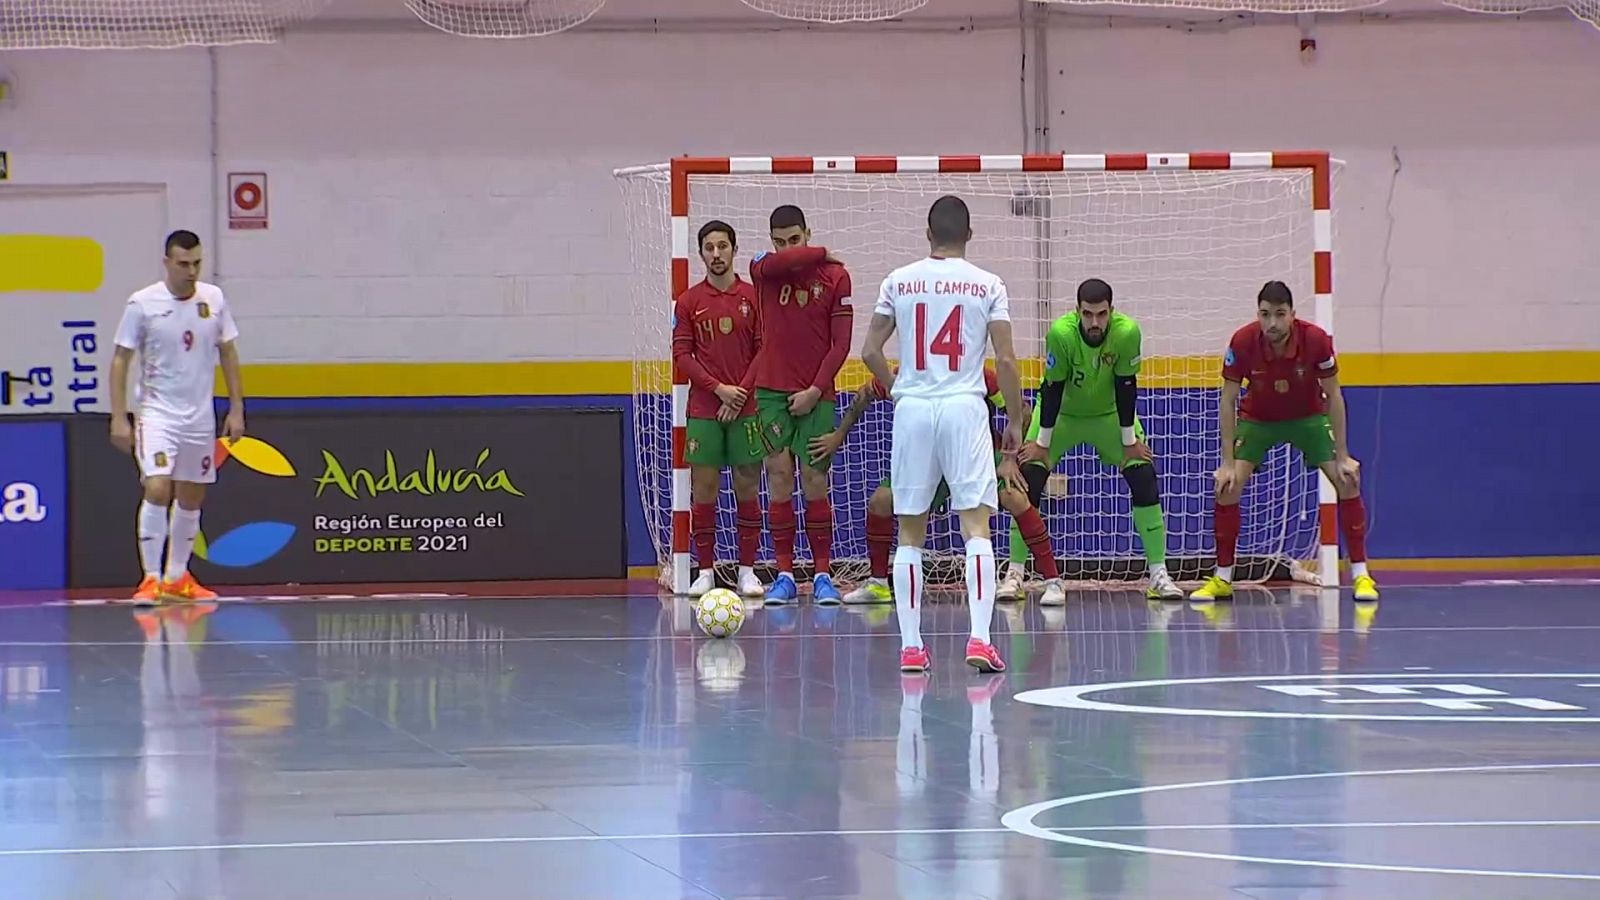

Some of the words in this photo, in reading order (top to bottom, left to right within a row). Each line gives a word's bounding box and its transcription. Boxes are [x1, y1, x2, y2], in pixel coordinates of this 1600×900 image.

[778, 284, 792, 306] 8
[898, 278, 928, 296] RAÚL
[935, 281, 988, 298] CAMPOS
[182, 330, 195, 351] 9
[695, 318, 715, 342] 14
[913, 302, 965, 372] 14
[200, 455, 212, 475] 9
[313, 447, 526, 499] Andalucía
[0, 481, 47, 522] a
[314, 513, 382, 533] Región
[387, 514, 468, 532] Europea
[473, 512, 503, 528] del
[314, 537, 413, 553] DEPORTE
[417, 535, 468, 552] 2021
